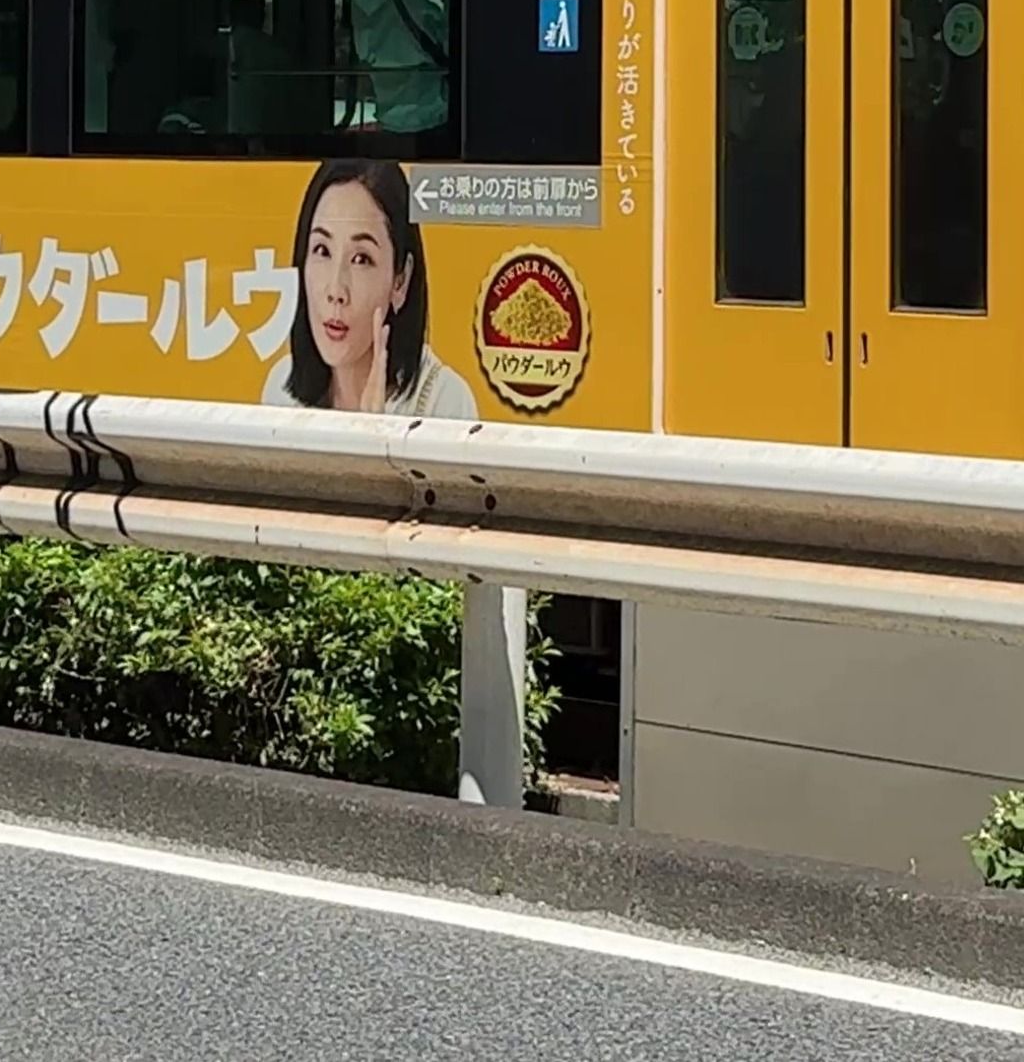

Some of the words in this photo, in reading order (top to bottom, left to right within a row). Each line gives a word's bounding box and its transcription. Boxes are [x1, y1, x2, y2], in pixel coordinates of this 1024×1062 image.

[439, 175, 598, 201] お乗りの方は前扉から
[439, 200, 475, 216] Please
[478, 202, 505, 216] enter
[509, 202, 533, 216] from
[536, 202, 553, 218] the
[556, 202, 582, 218] front
[493, 259, 540, 298] POWDER
[541, 263, 573, 302] ROUX
[492, 353, 572, 377] パウダールウ
